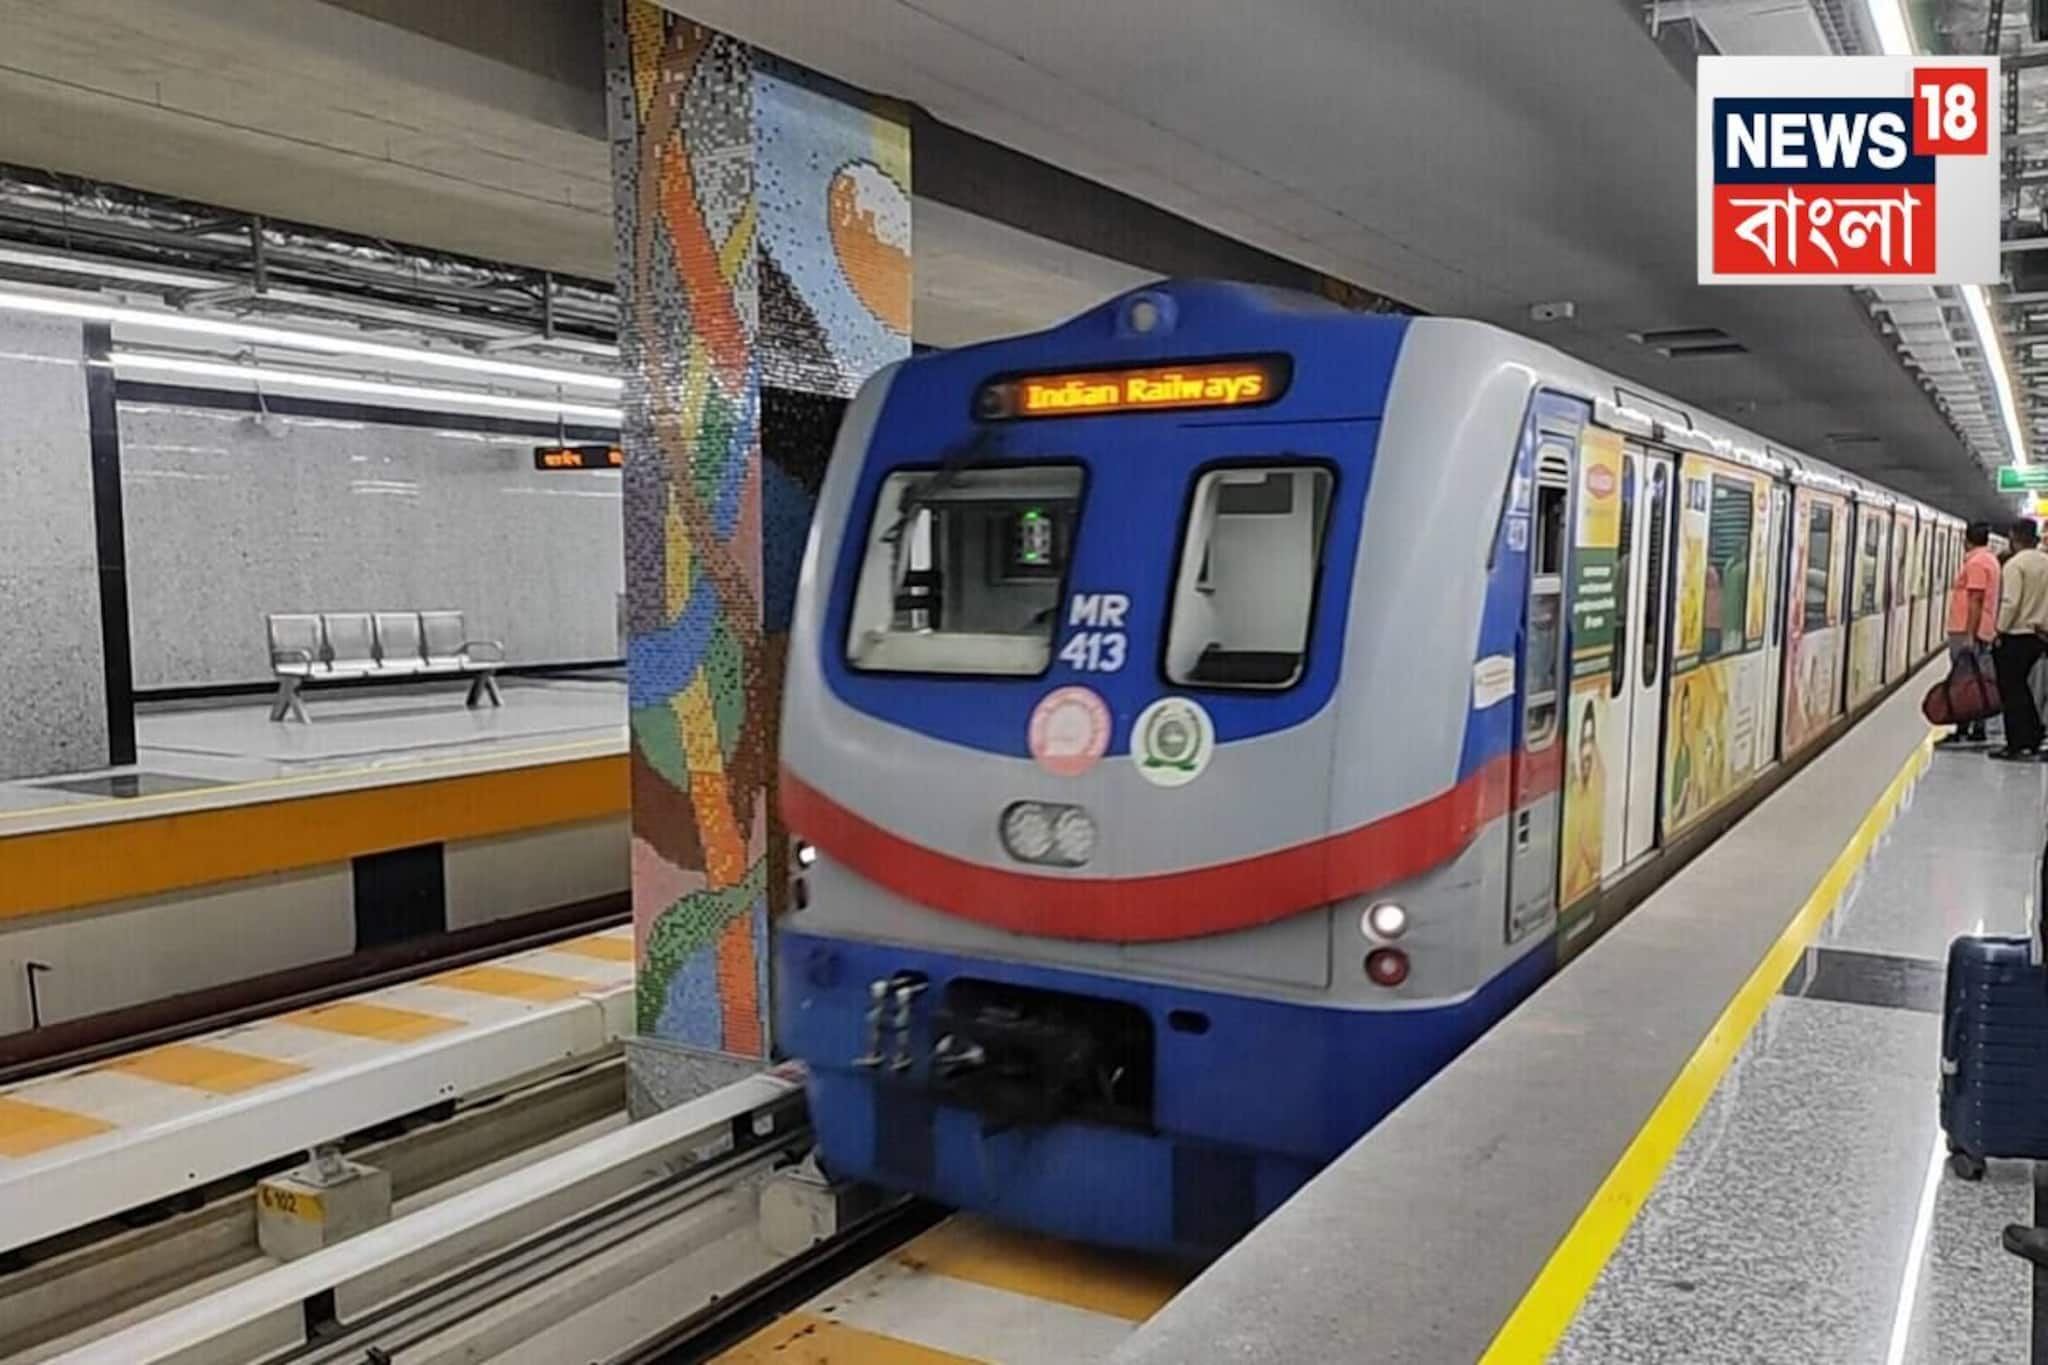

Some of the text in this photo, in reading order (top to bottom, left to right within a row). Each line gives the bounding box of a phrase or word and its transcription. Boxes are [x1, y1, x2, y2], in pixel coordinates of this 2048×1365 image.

[1025, 373, 1263, 410] Indian Railways
[1068, 593, 1130, 627] MR
[1058, 631, 1127, 672] 413
